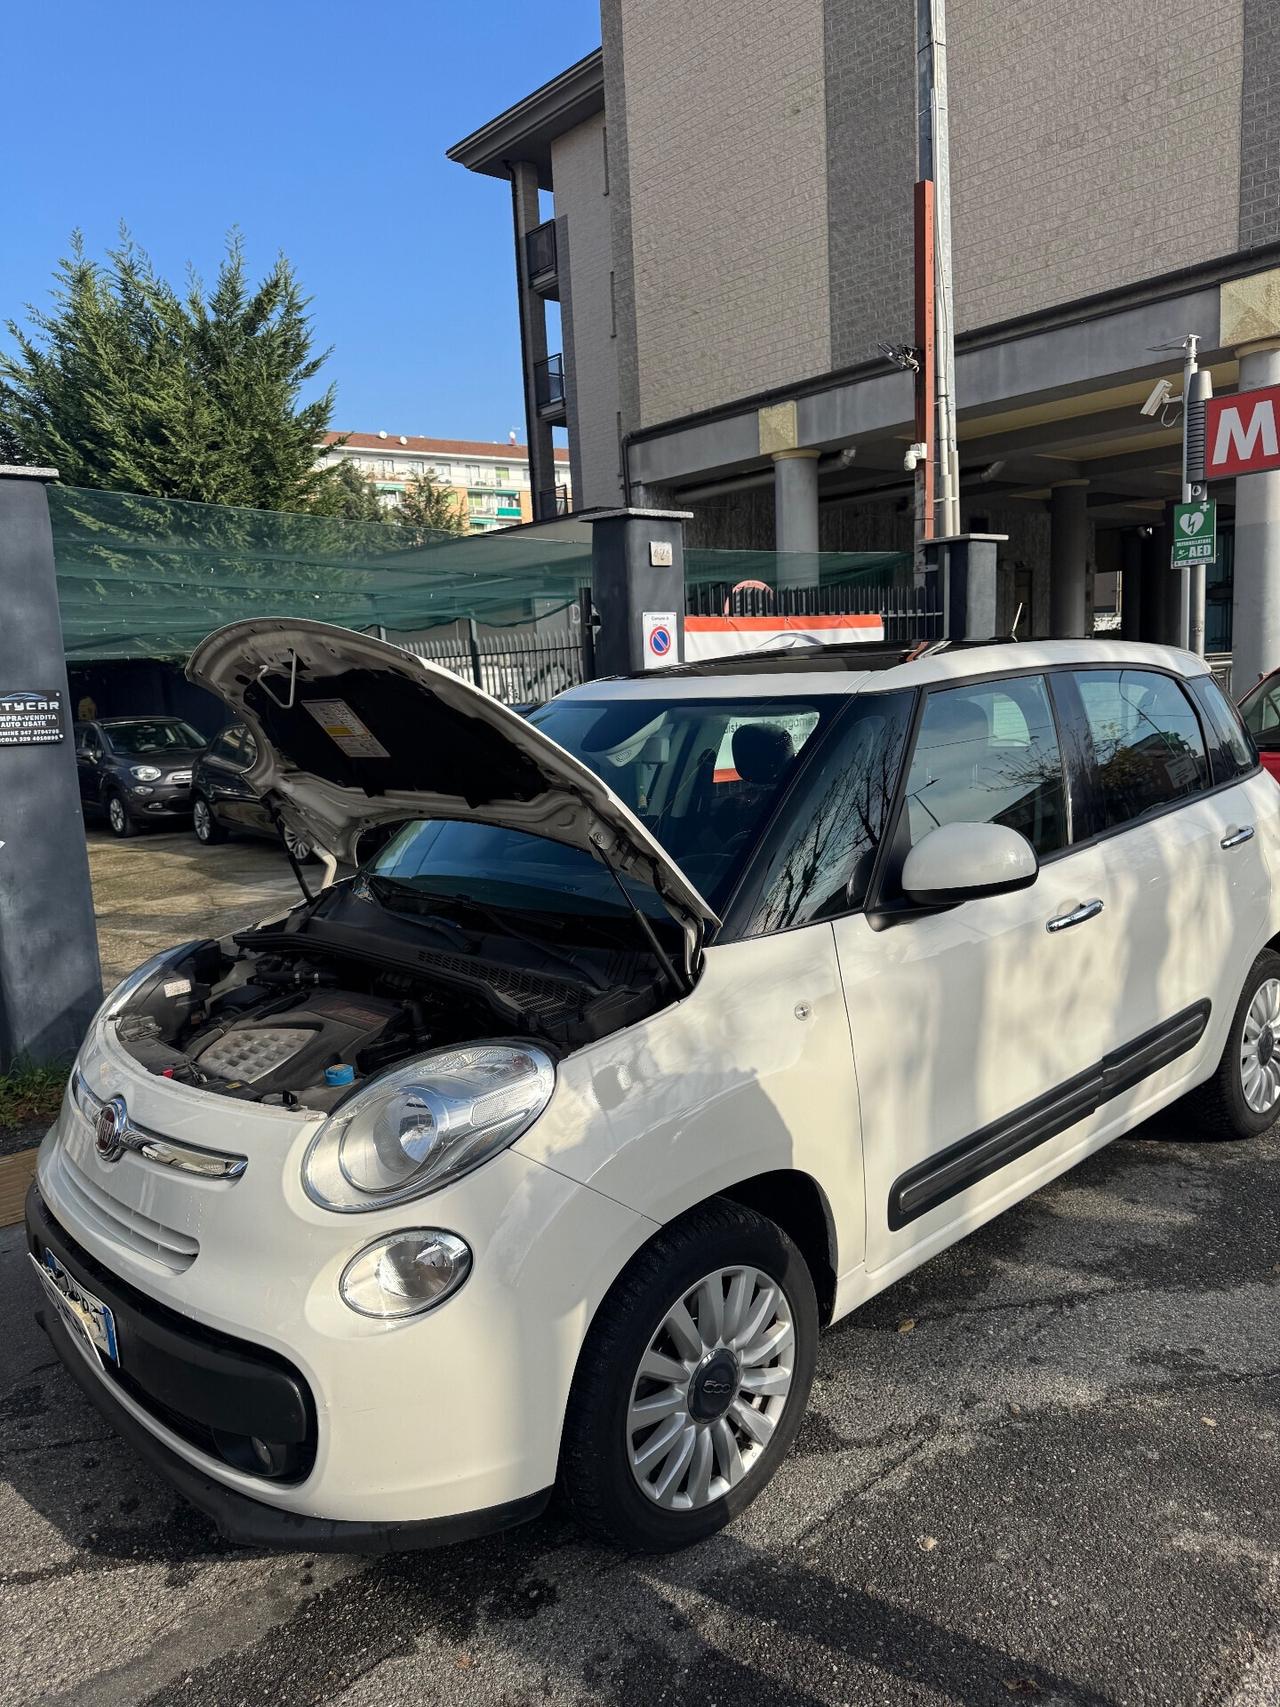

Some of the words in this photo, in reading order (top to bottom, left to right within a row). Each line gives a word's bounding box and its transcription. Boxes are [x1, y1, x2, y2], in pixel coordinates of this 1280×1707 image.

[1212, 399, 1279, 466] M
[1188, 544, 1212, 558] AED
[0, 702, 60, 711] TYCAR
[703, 1380, 731, 1393] 500
